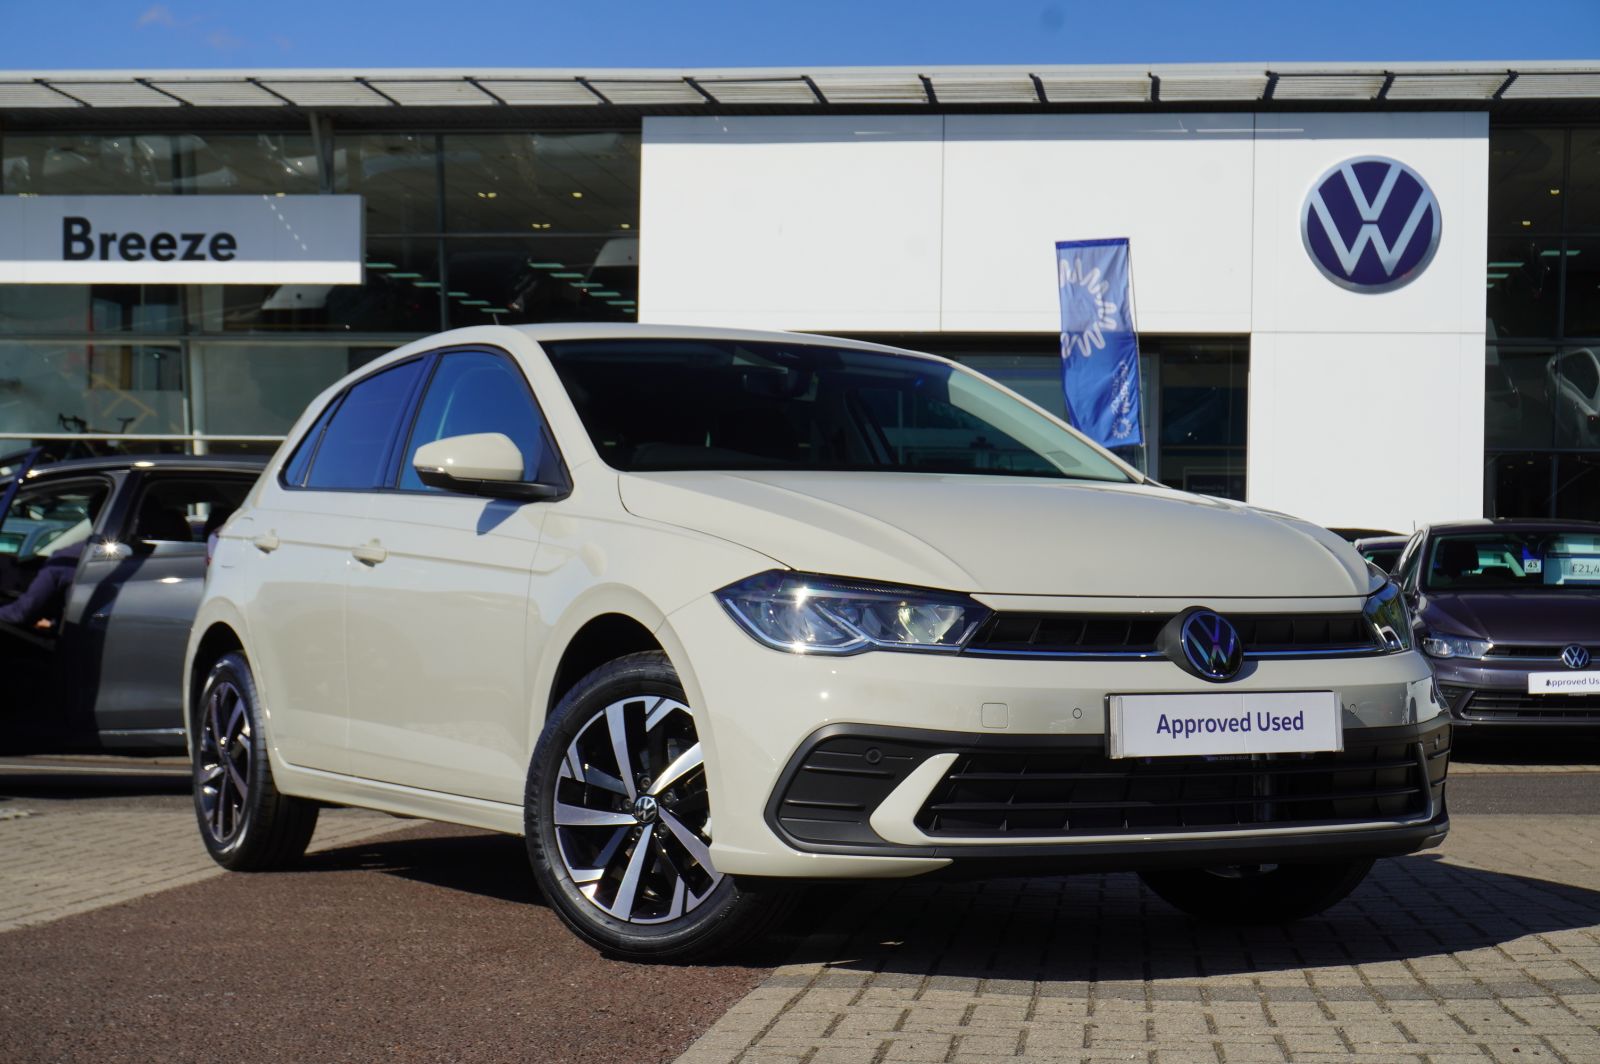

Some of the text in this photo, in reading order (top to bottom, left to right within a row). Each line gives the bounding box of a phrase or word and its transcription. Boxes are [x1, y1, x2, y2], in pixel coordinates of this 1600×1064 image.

[63, 216, 237, 261] Breeze
[1303, 157, 1440, 288] VW
[1545, 678, 1587, 687] Approved
[1156, 710, 1304, 739] Approved Used
